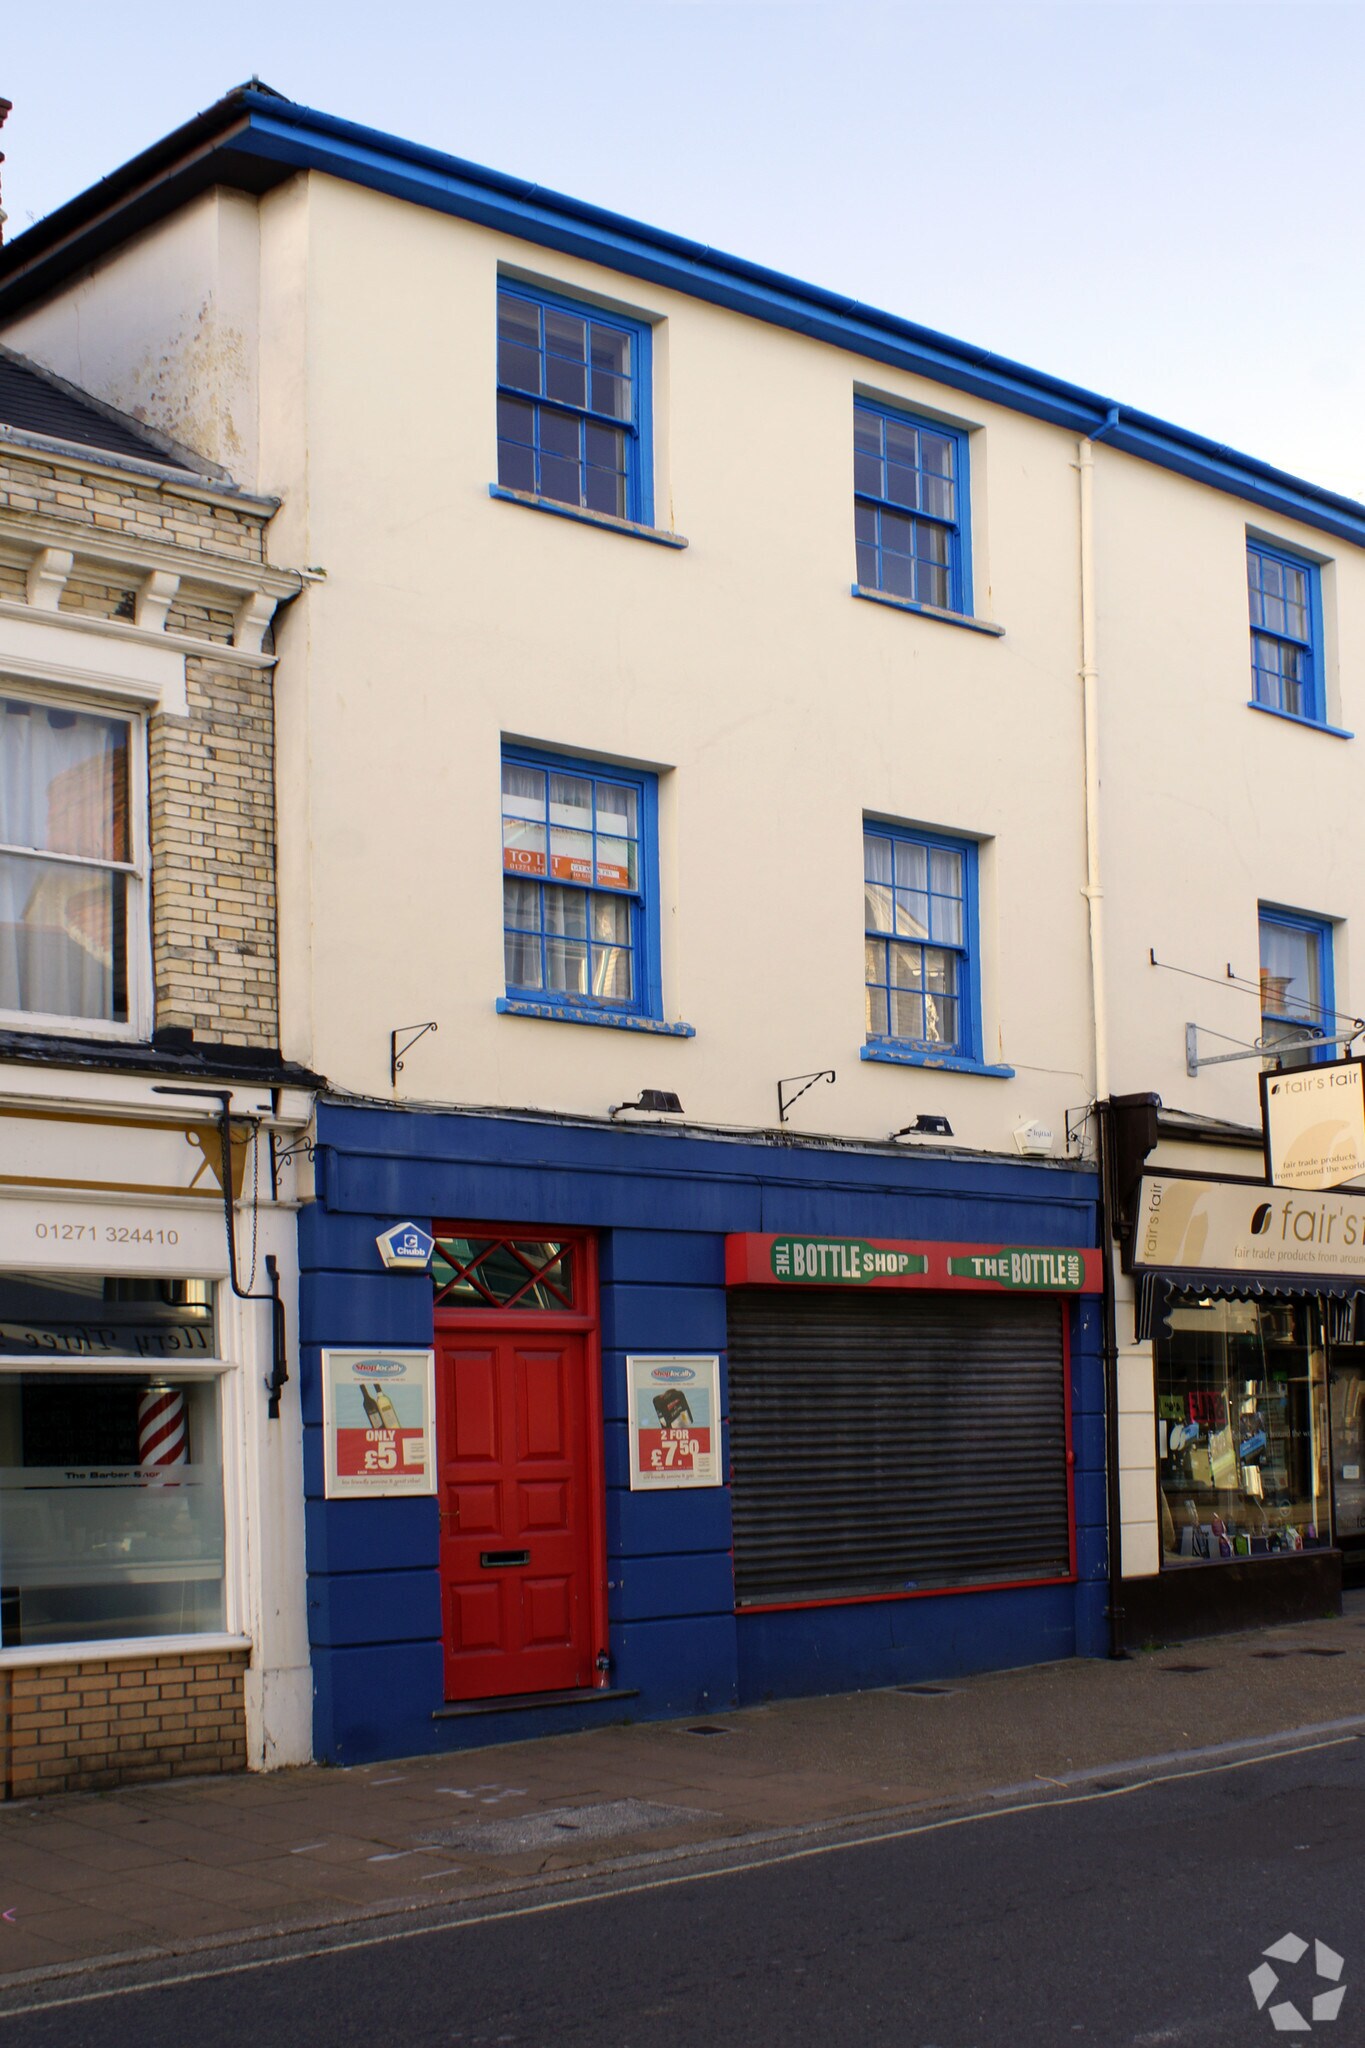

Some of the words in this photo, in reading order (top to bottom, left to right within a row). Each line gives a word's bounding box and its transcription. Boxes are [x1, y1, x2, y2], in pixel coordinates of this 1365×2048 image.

[509, 850, 531, 864] TO
[537, 854, 560, 869] LT
[1285, 1078, 1325, 1094] fair's
[1329, 1071, 1358, 1087] fair
[1275, 1172, 1294, 1180] from
[1295, 1168, 1324, 1177] around
[1326, 1165, 1340, 1173] the
[1342, 1162, 1365, 1172] world
[1298, 1158, 1319, 1167] trade
[1321, 1153, 1356, 1165] products
[1149, 1183, 1162, 1212] fair
[1282, 1200, 1358, 1245] fair's
[35, 1223, 97, 1241] 01271
[105, 1226, 179, 1245] 324410
[1144, 1216, 1159, 1258] fair's
[397, 1246, 426, 1256] Chubb
[776, 1243, 790, 1275] THE
[793, 1243, 861, 1278] BOTTLE
[863, 1253, 909, 1273] SHOP
[1234, 1246, 1249, 1258] fair
[1252, 1247, 1275, 1260] trade
[1277, 1249, 1316, 1262] products
[1318, 1250, 1338, 1262] from
[971, 1258, 1009, 1277] THE
[1011, 1253, 1066, 1285] BOTTLE
[1068, 1255, 1080, 1285] SHOP
[365, 1430, 396, 1442] ONLY
[660, 1430, 667, 1440] 2
[669, 1429, 689, 1440] FOR
[364, 1441, 397, 1469] £5
[651, 1439, 699, 1467] £7.50
[90, 1471, 130, 1479] Barber
